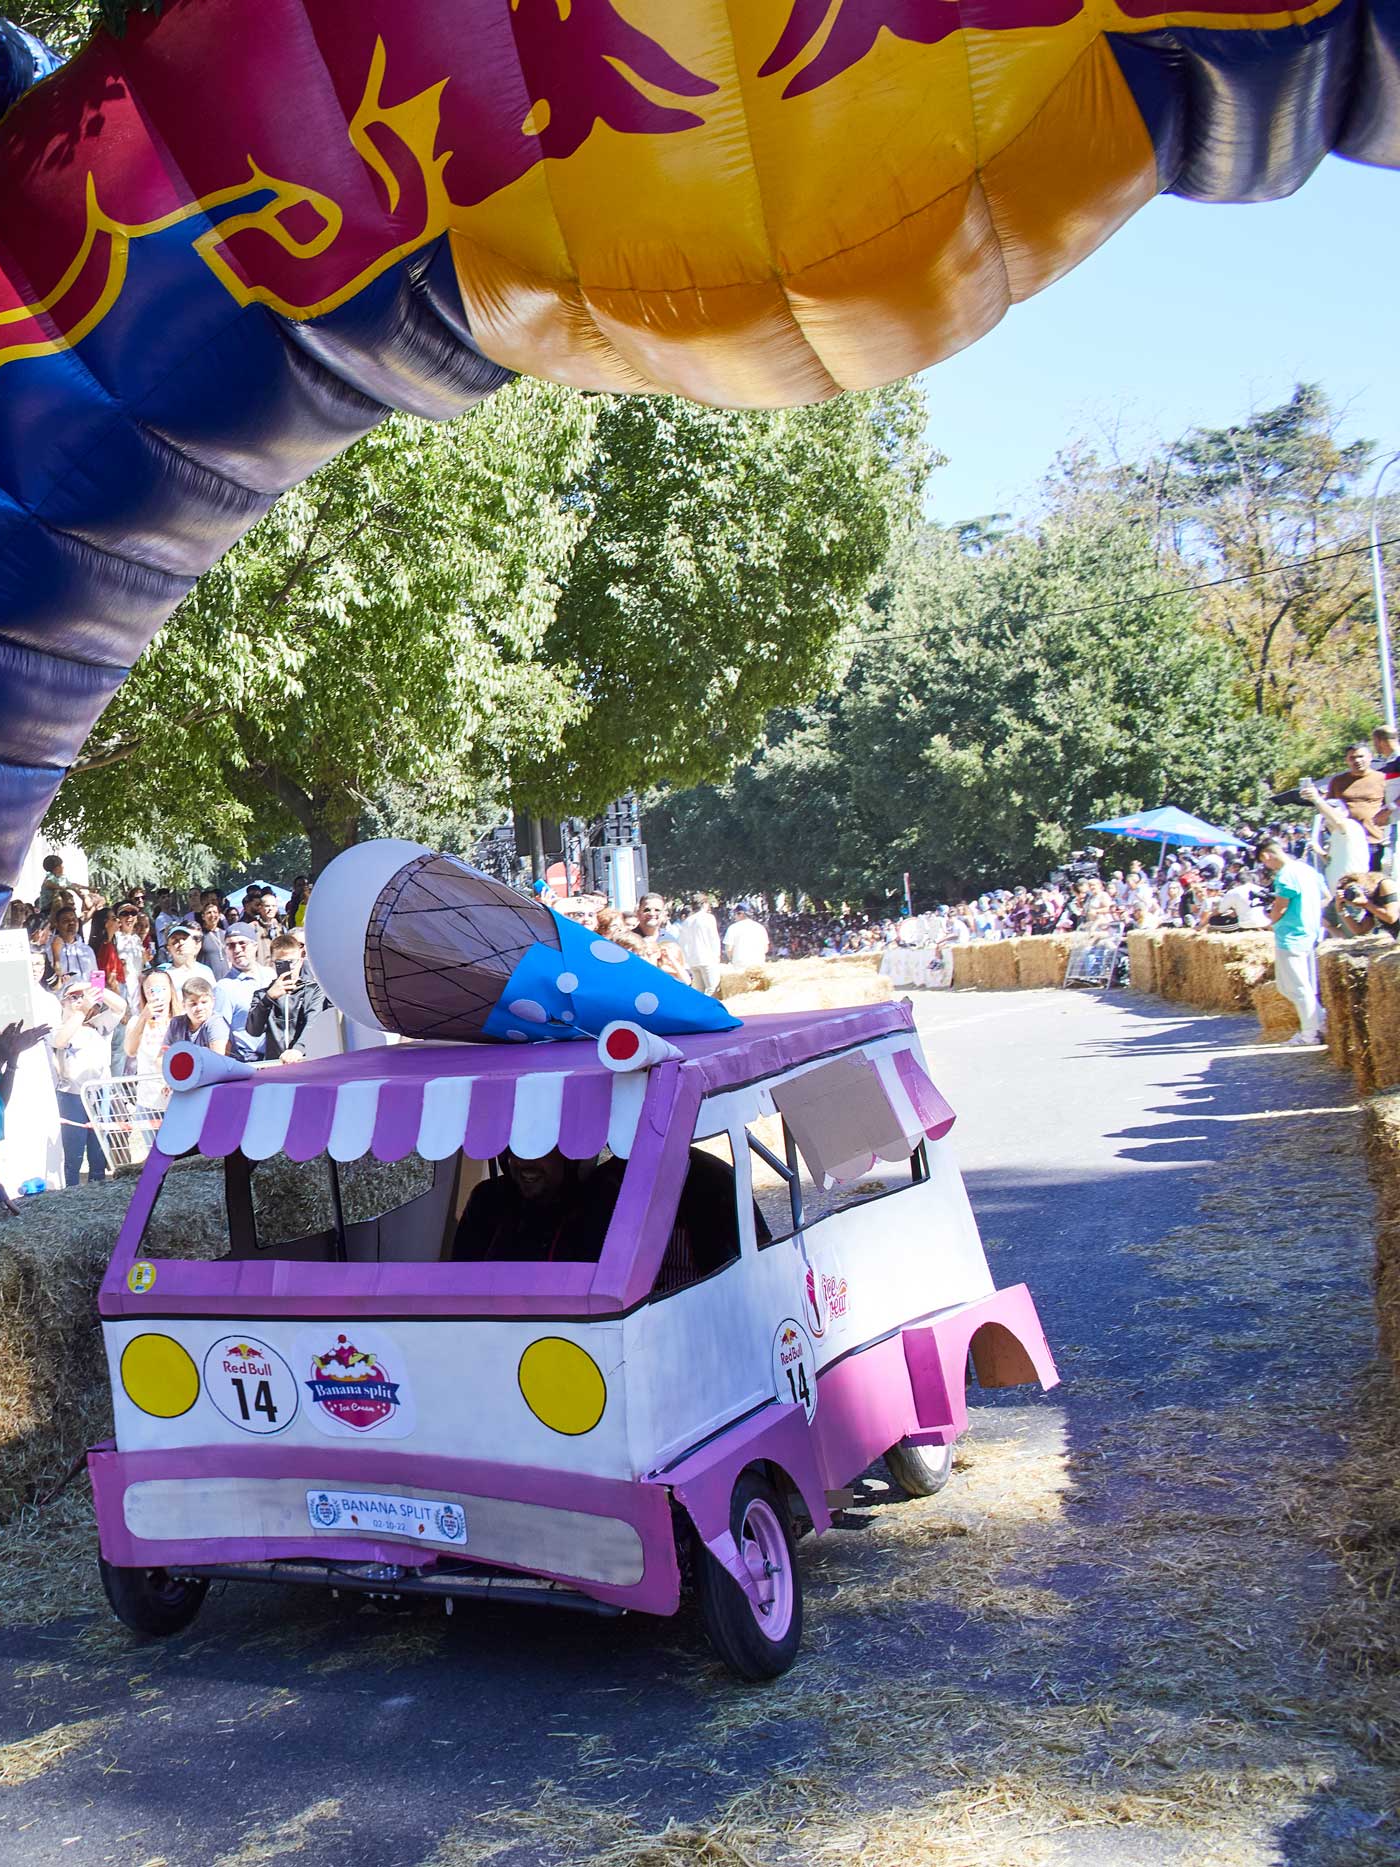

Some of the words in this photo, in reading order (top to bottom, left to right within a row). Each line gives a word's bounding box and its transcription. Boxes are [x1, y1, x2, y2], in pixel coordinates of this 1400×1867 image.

[223, 1360, 247, 1374] Red
[248, 1362, 272, 1376] Bull
[315, 1384, 362, 1397] Banana
[363, 1384, 392, 1399] split
[786, 1362, 810, 1408] 14
[231, 1378, 278, 1423] 14
[338, 1404, 350, 1412] Ice
[351, 1402, 375, 1412] Cream
[341, 1498, 398, 1515] BANANA
[400, 1503, 433, 1521] SPLIT
